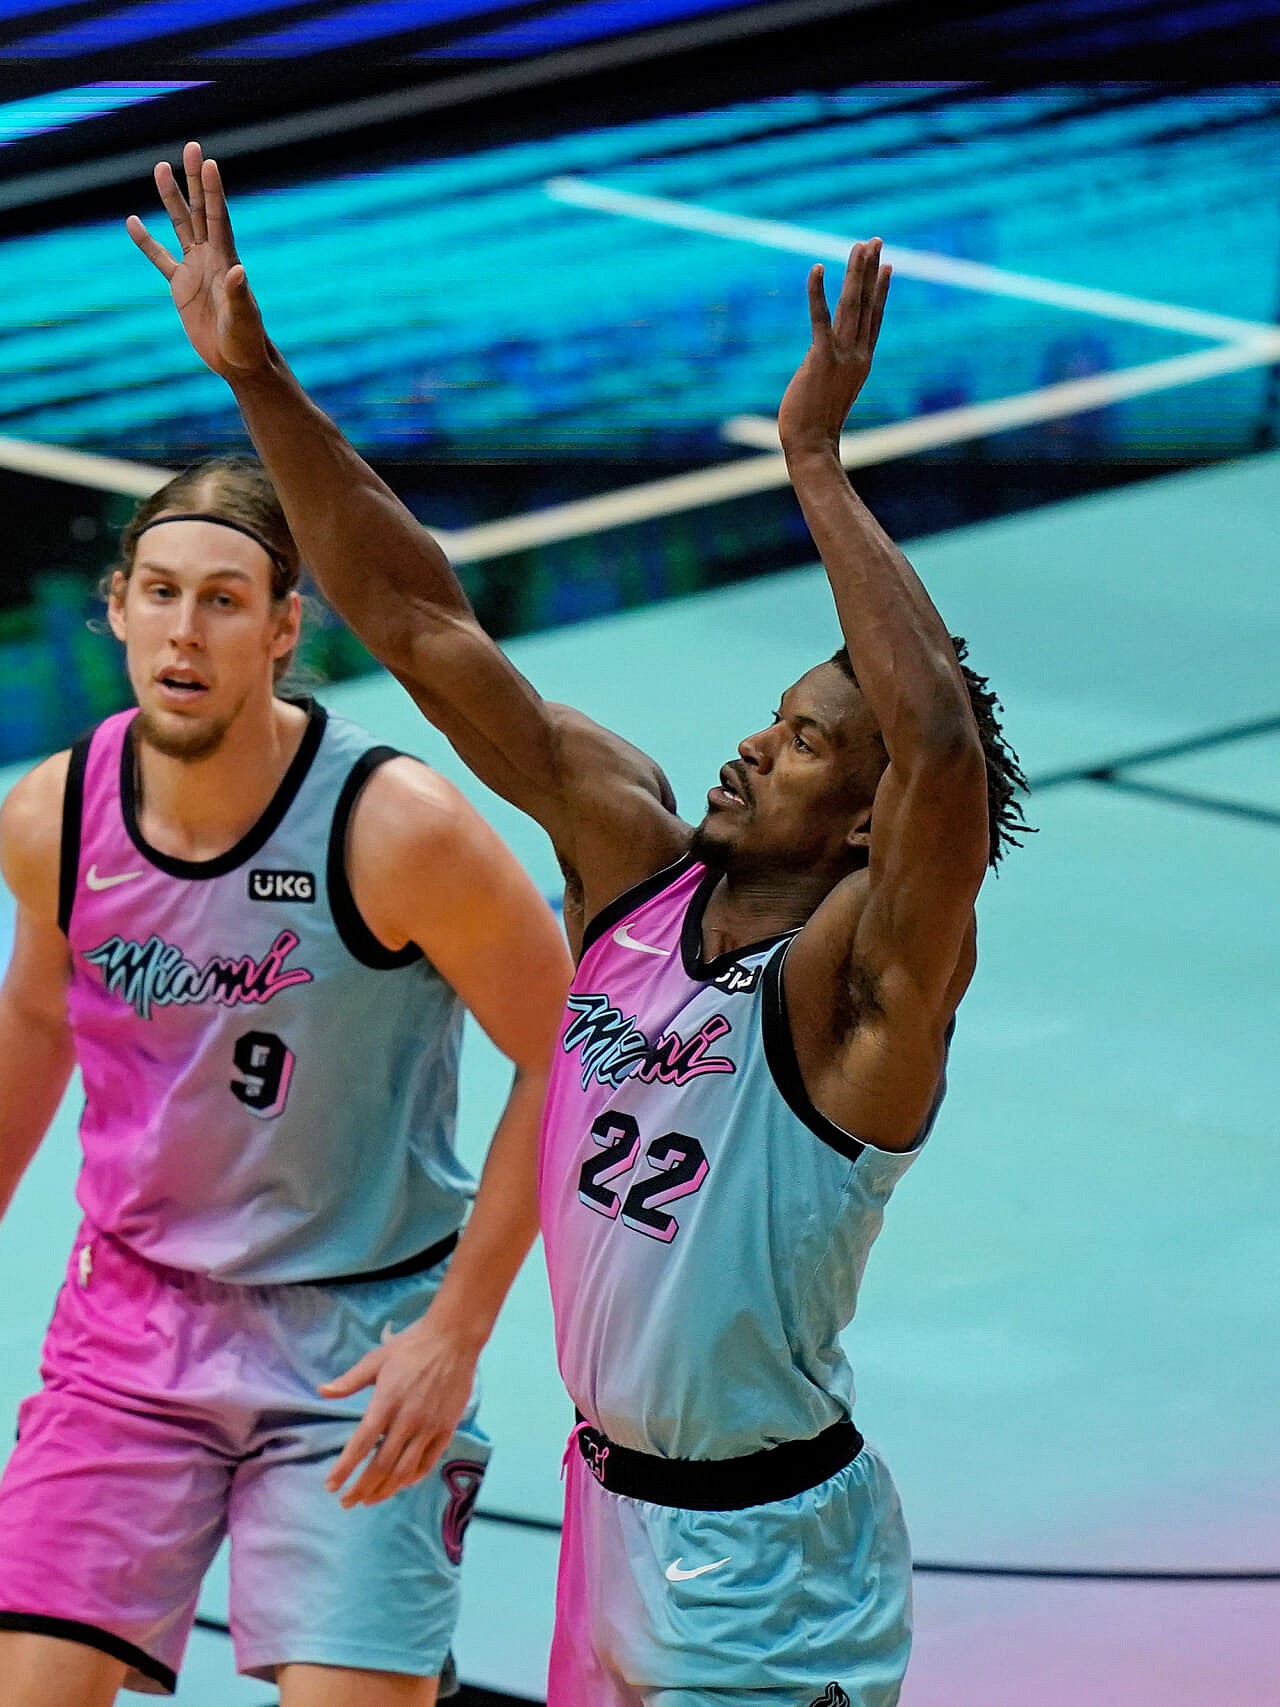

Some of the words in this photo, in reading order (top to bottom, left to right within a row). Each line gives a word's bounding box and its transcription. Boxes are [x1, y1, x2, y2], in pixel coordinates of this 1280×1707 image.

[253, 875, 312, 898] UKG
[82, 929, 314, 1021] Miami
[230, 1030, 296, 1121] 9
[577, 1110, 710, 1244] 22
